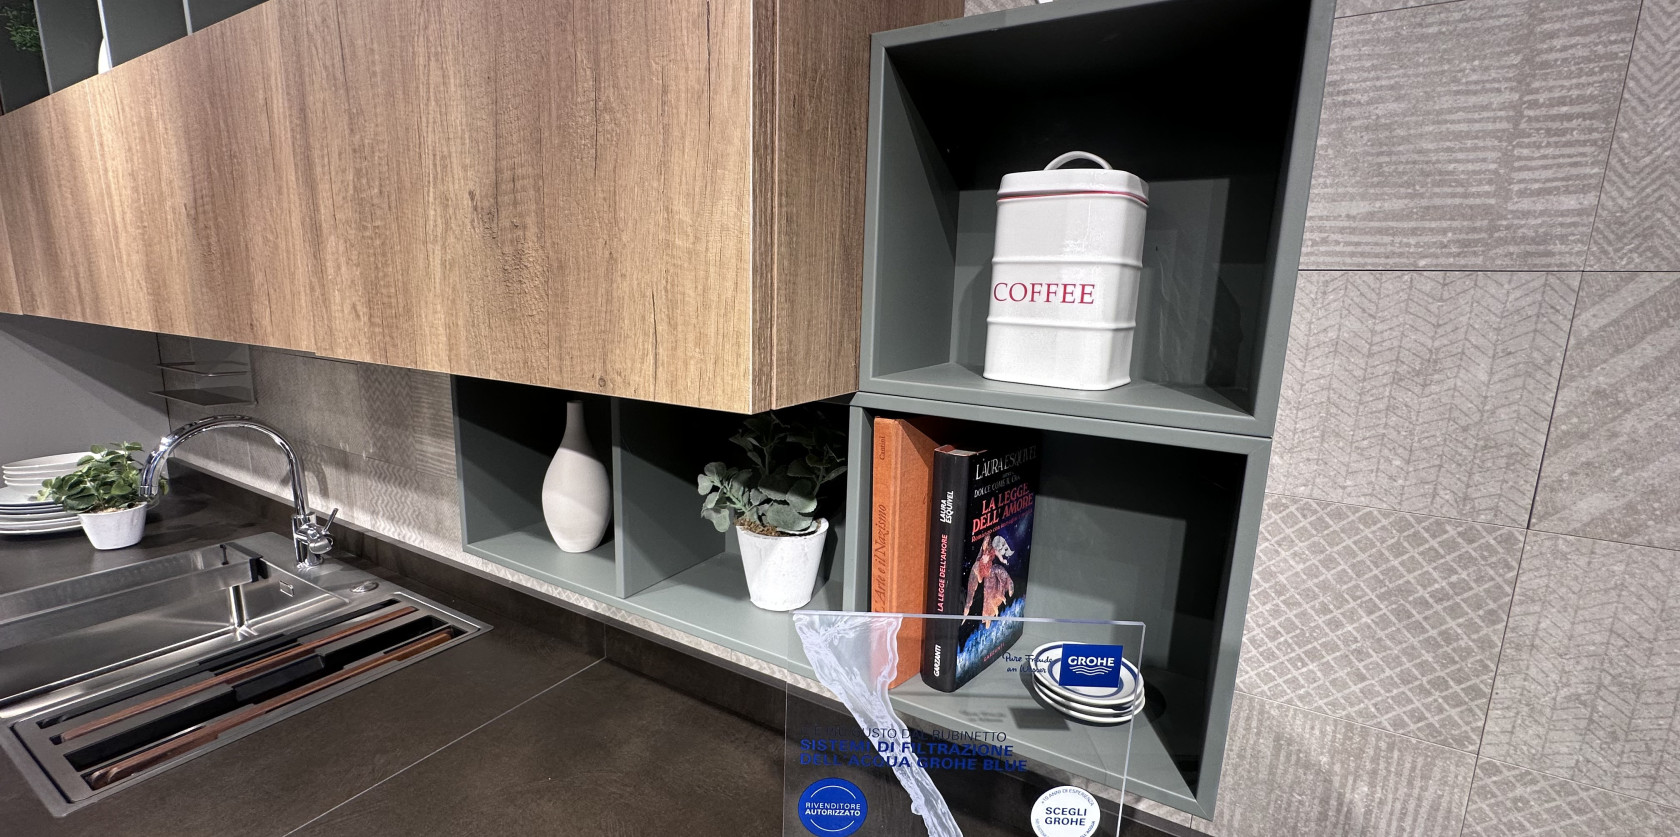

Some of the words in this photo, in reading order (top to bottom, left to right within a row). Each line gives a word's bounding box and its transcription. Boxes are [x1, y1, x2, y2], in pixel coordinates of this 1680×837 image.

[993, 282, 1096, 305] COFFEE
[879, 435, 887, 461] Cantini
[975, 457, 1004, 480] LAURA
[974, 484, 992, 498] DOLCE
[981, 496, 996, 514] LA
[997, 482, 1030, 508] LEGGE
[939, 499, 947, 523] LAURA
[945, 490, 954, 524] ESQUIVEL
[874, 504, 890, 556] Nazismo
[874, 555, 886, 567] il
[939, 534, 948, 578] DELL'AMORE
[938, 577, 946, 603] LEGGE
[937, 602, 944, 612] LA
[933, 644, 942, 677] GARZANTI
[1002, 652, 1022, 663] Pure
[1067, 655, 1115, 667] GROHE
[851, 726, 897, 739] GUSTO
[901, 728, 928, 740] DAL
[932, 729, 1007, 743] RUBINETTO
[800, 738, 871, 753] SISTEMI
[877, 740, 895, 753] DI
[901, 741, 1014, 757] FILTRAZIONE
[800, 752, 911, 768] DELL'ACQUA
[916, 756, 980, 770] GROHE
[982, 759, 1028, 772] BLUE
[804, 808, 861, 817] AUTORIZZATO
[805, 802, 861, 810] RIVENDITORE
[1045, 806, 1087, 817] SCEGLI
[1044, 816, 1087, 826] GROHE
